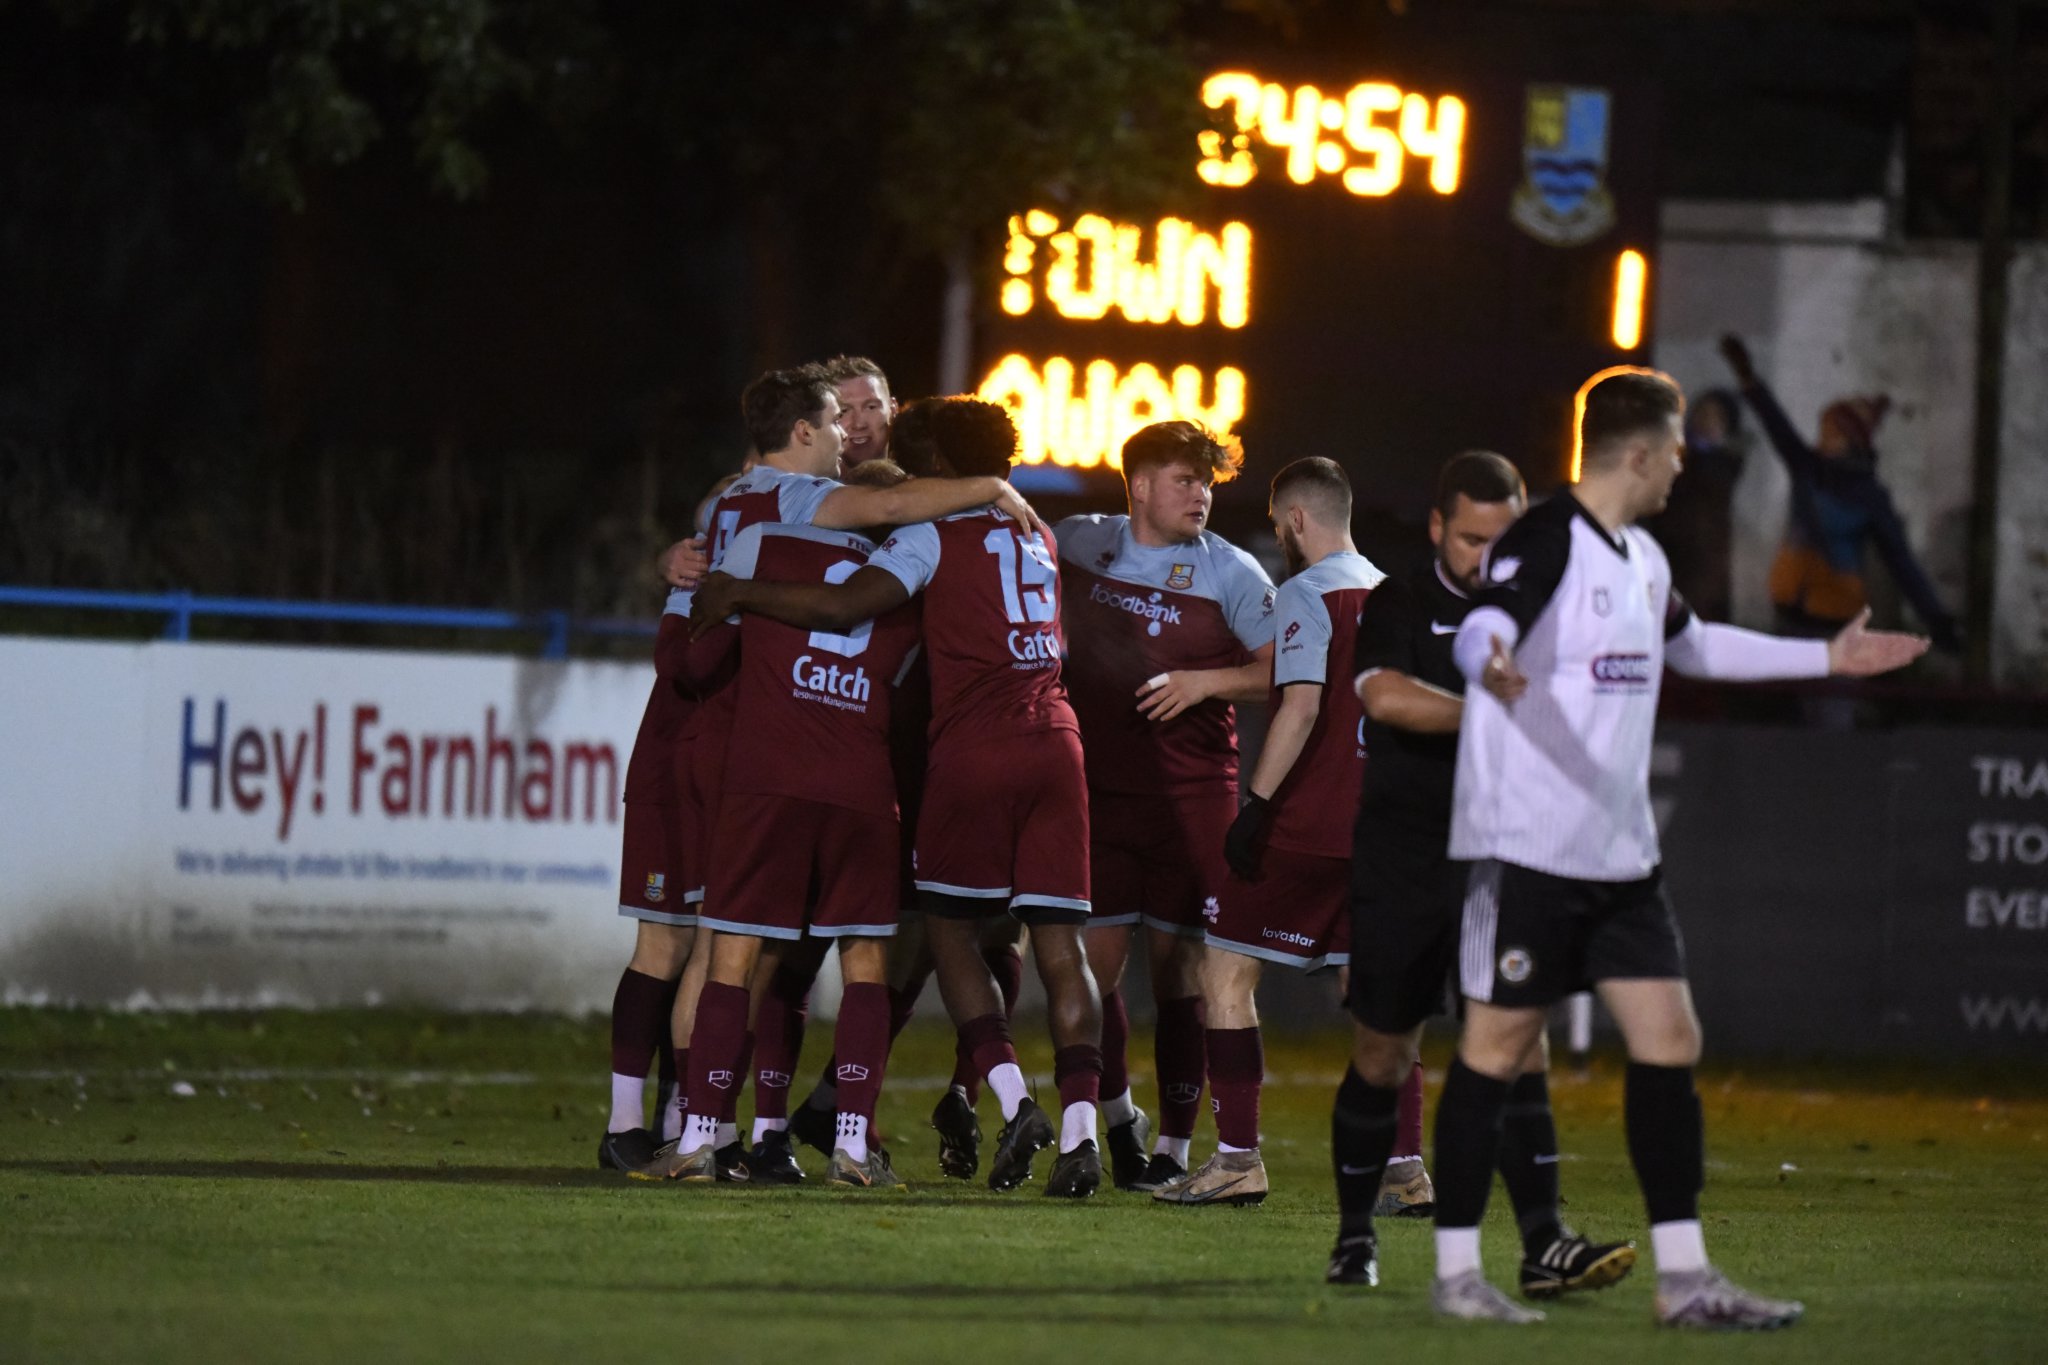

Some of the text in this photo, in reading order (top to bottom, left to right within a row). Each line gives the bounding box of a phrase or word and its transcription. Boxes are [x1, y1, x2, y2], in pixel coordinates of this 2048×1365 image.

[977, 352, 1245, 472] AWAY
[983, 527, 1057, 623] 15
[1089, 583, 1182, 625] foodbank
[792, 655, 871, 702] Catch
[822, 694, 867, 714] Management
[179, 696, 618, 842] Hey! Farnham
[1966, 821, 2048, 865] STO
[1261, 926, 1316, 949] lavastar
